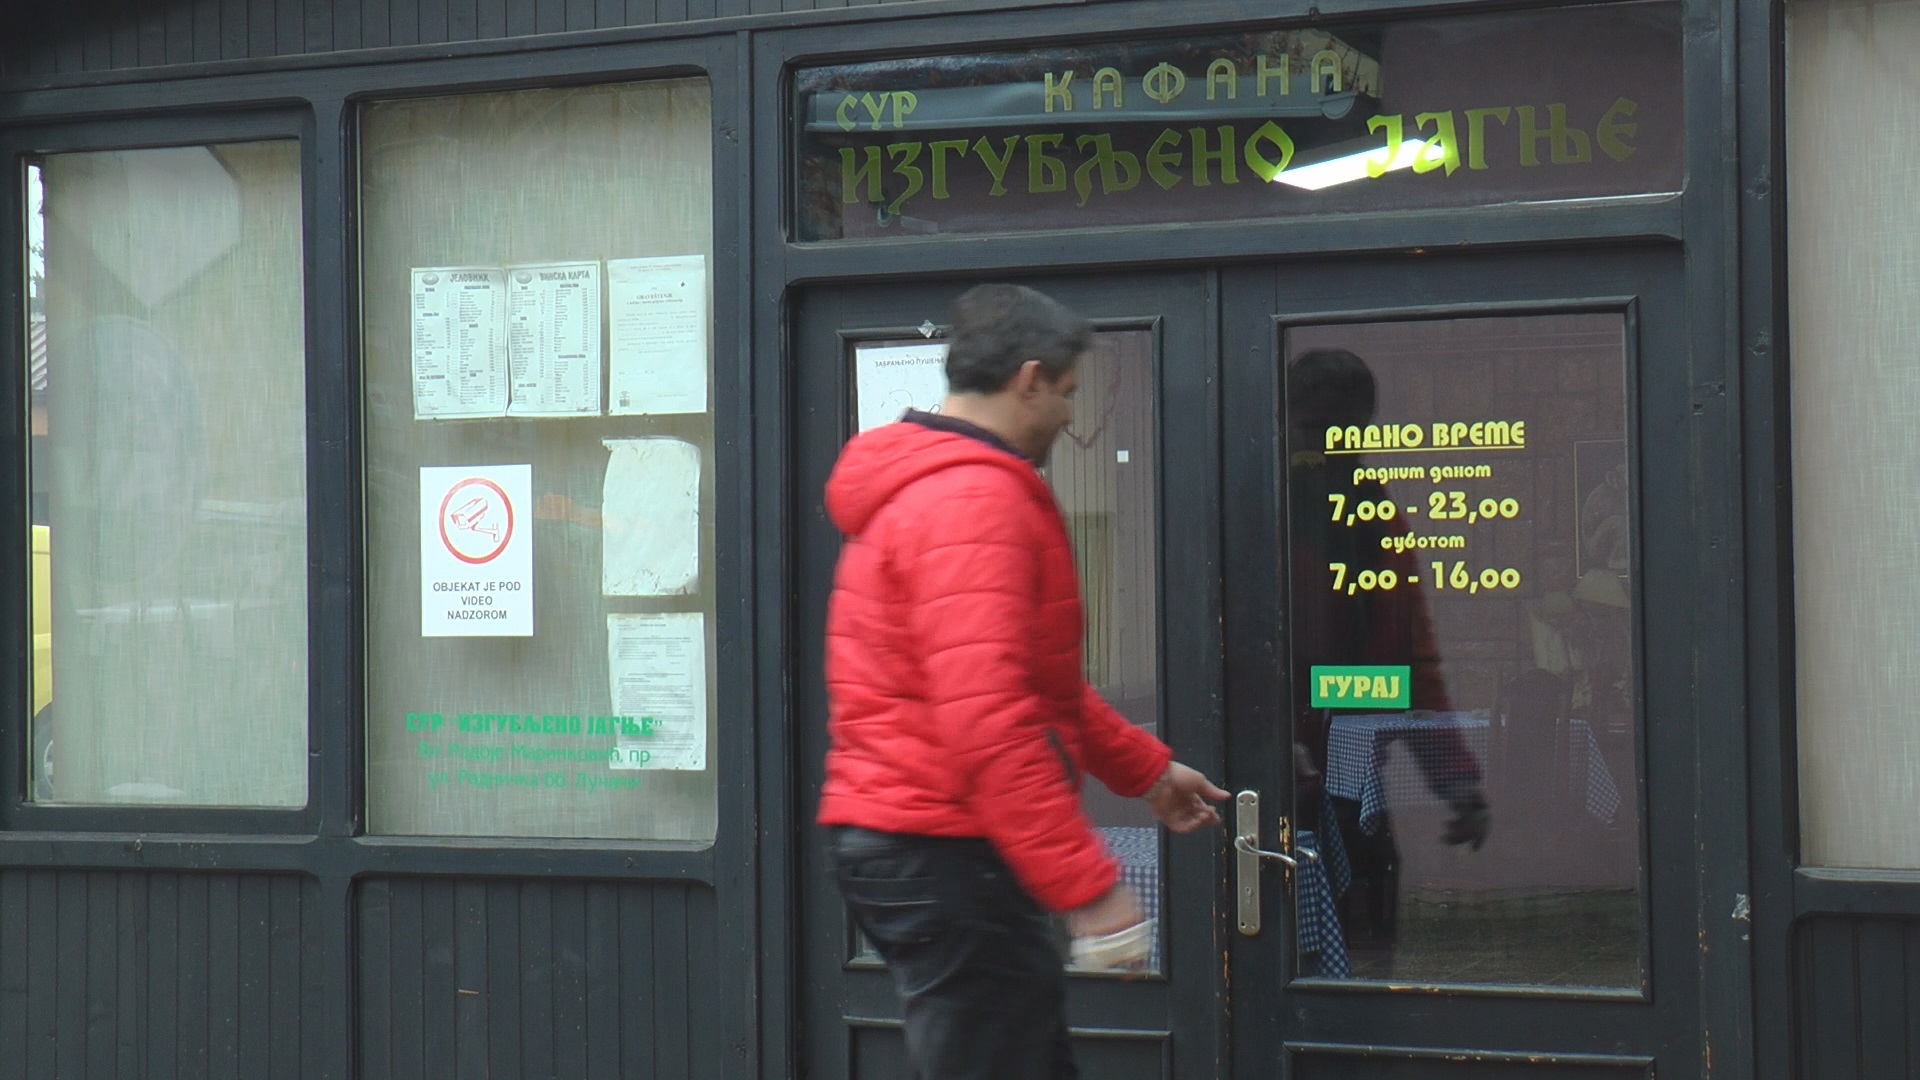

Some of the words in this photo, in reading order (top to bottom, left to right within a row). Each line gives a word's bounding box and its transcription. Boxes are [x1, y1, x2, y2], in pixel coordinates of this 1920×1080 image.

[1044, 50, 1342, 112] КАФАНА
[836, 91, 917, 132] СУР
[838, 120, 1294, 214] ИЗГУБЉЕНО
[1366, 97, 1638, 178] ЈАГЊЕ
[449, 272, 490, 283] ЈЕЛОВНИК
[568, 270, 590, 280] КАРТА
[874, 359, 915, 368] ЗАБРАЊЕНО
[1325, 423, 1424, 449] РАДНО
[1432, 420, 1525, 448] ВРЕМЕ
[1353, 465, 1425, 486] радним
[1430, 464, 1491, 484] даном
[1380, 532, 1465, 554] суботом
[433, 581, 480, 592] OBJEKAT
[483, 581, 496, 592] JE
[498, 581, 521, 591] POD
[461, 596, 493, 606] VIDEO
[447, 610, 507, 620] NADZOROM
[1318, 674, 1401, 699] ГУРАЈ
[405, 712, 443, 731] СУР
[629, 748, 651, 767] пр
